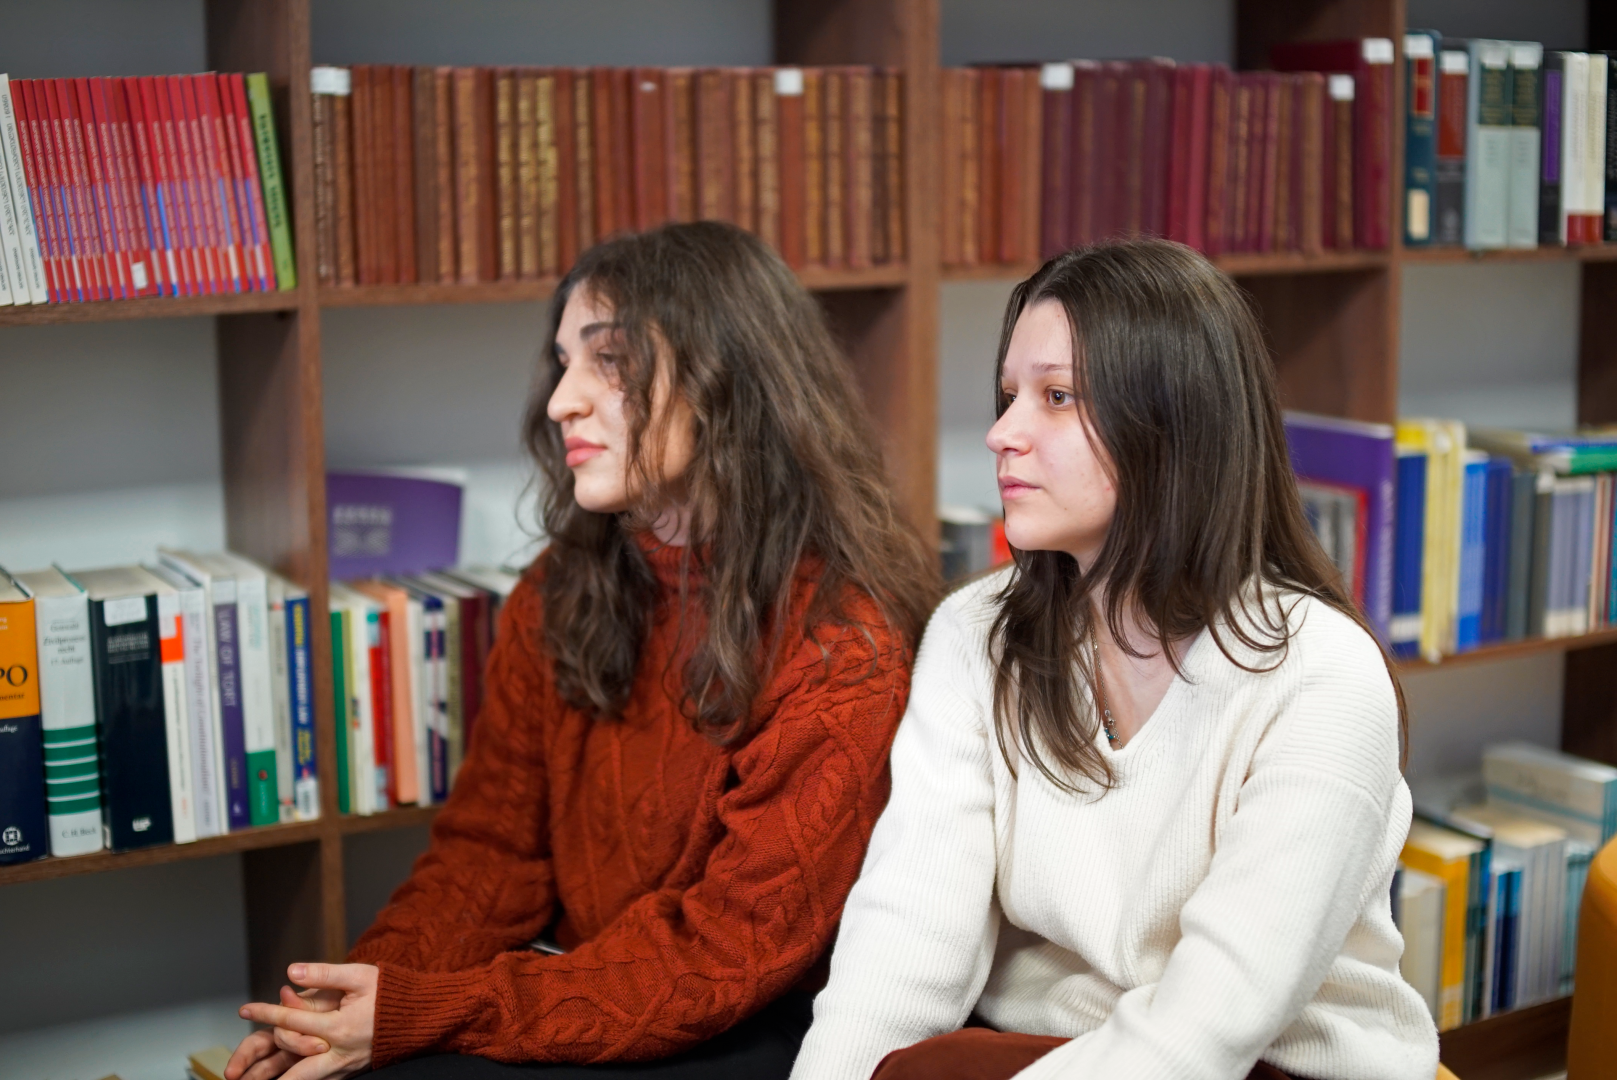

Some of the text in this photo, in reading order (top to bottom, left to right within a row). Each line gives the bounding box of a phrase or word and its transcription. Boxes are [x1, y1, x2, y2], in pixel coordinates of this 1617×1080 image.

[217, 608, 237, 707] LAW OF TORT
